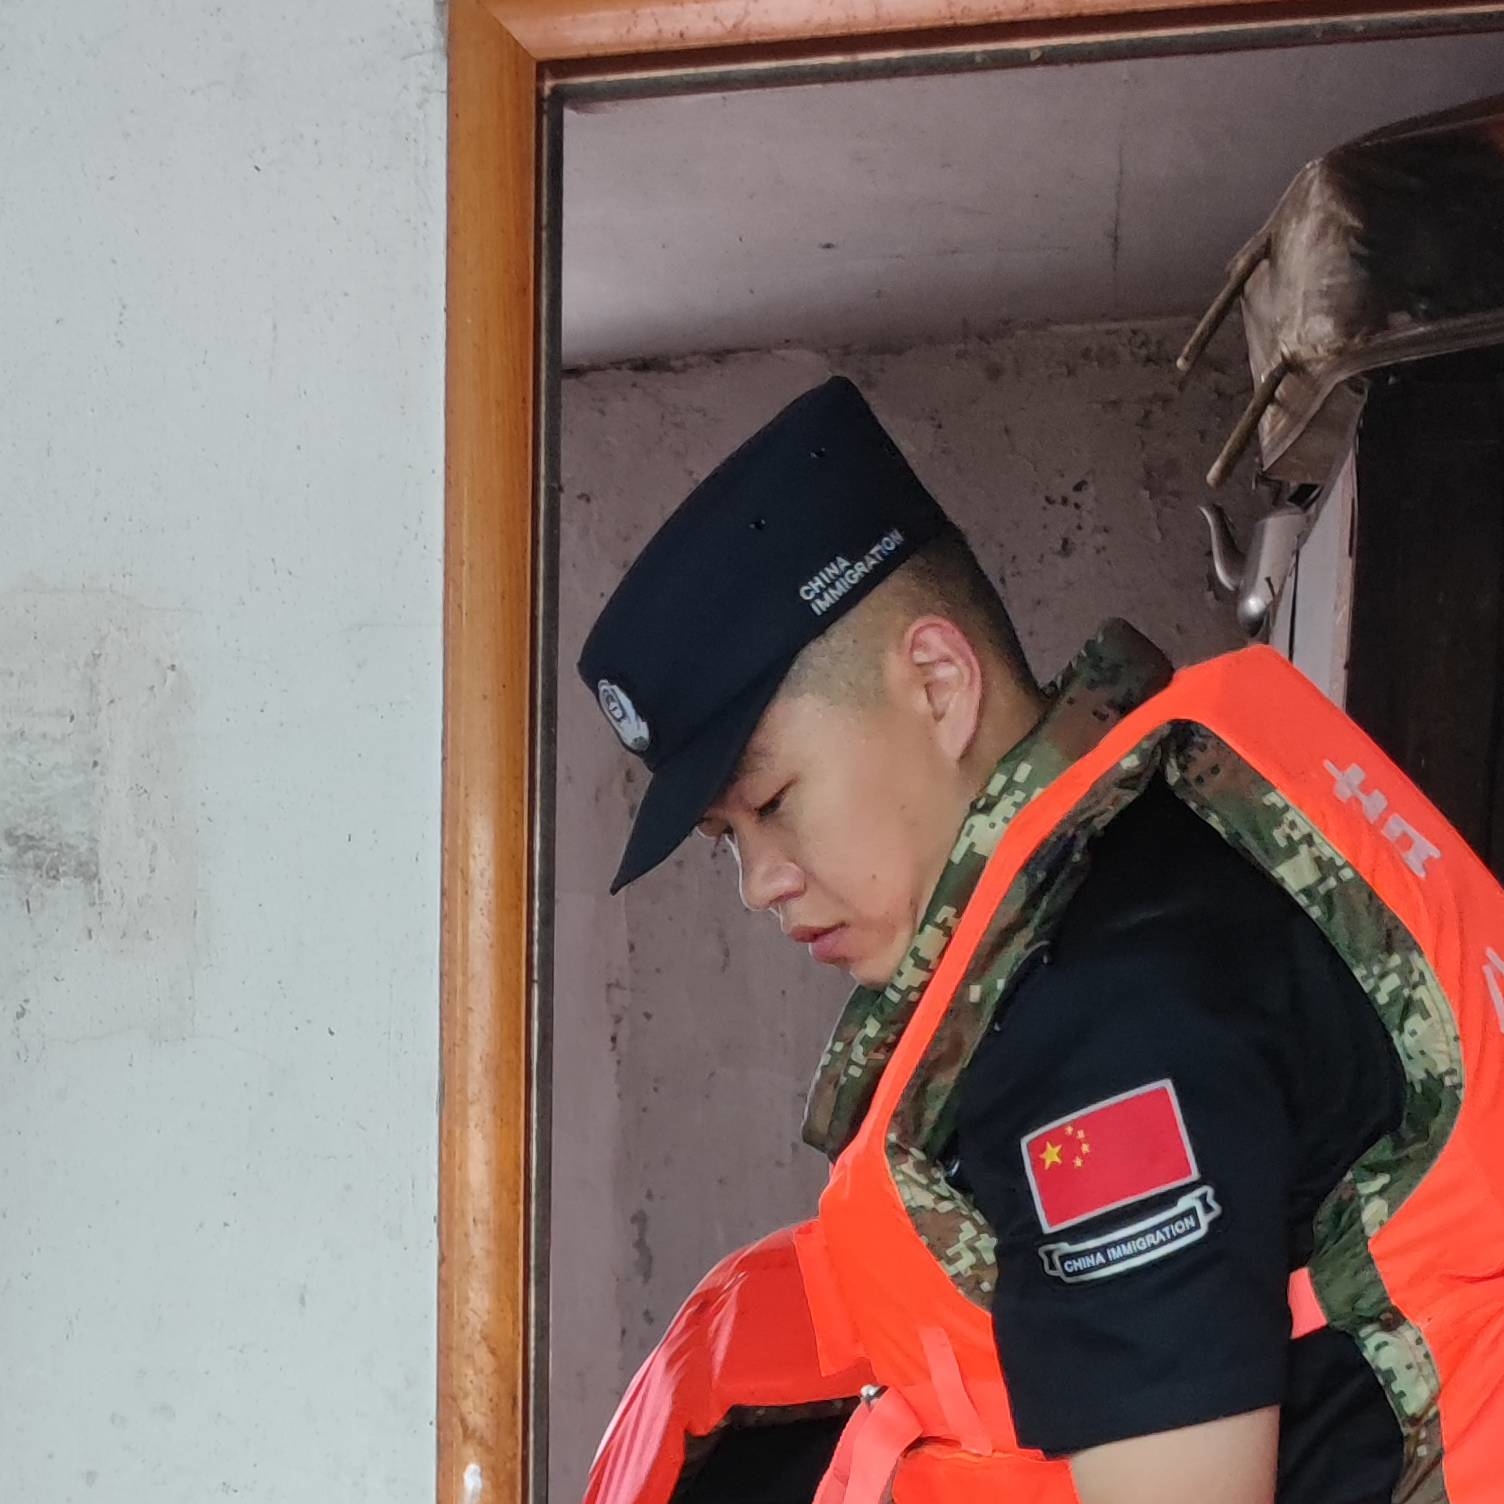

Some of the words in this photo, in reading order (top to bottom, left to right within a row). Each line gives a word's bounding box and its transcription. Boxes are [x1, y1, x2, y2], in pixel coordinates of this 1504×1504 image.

[800, 556, 851, 600] CHINA
[809, 528, 904, 616] IMMIGRATION
[1063, 1254, 1106, 1274] CHINA
[1107, 1214, 1196, 1262] IMMIGRATION
